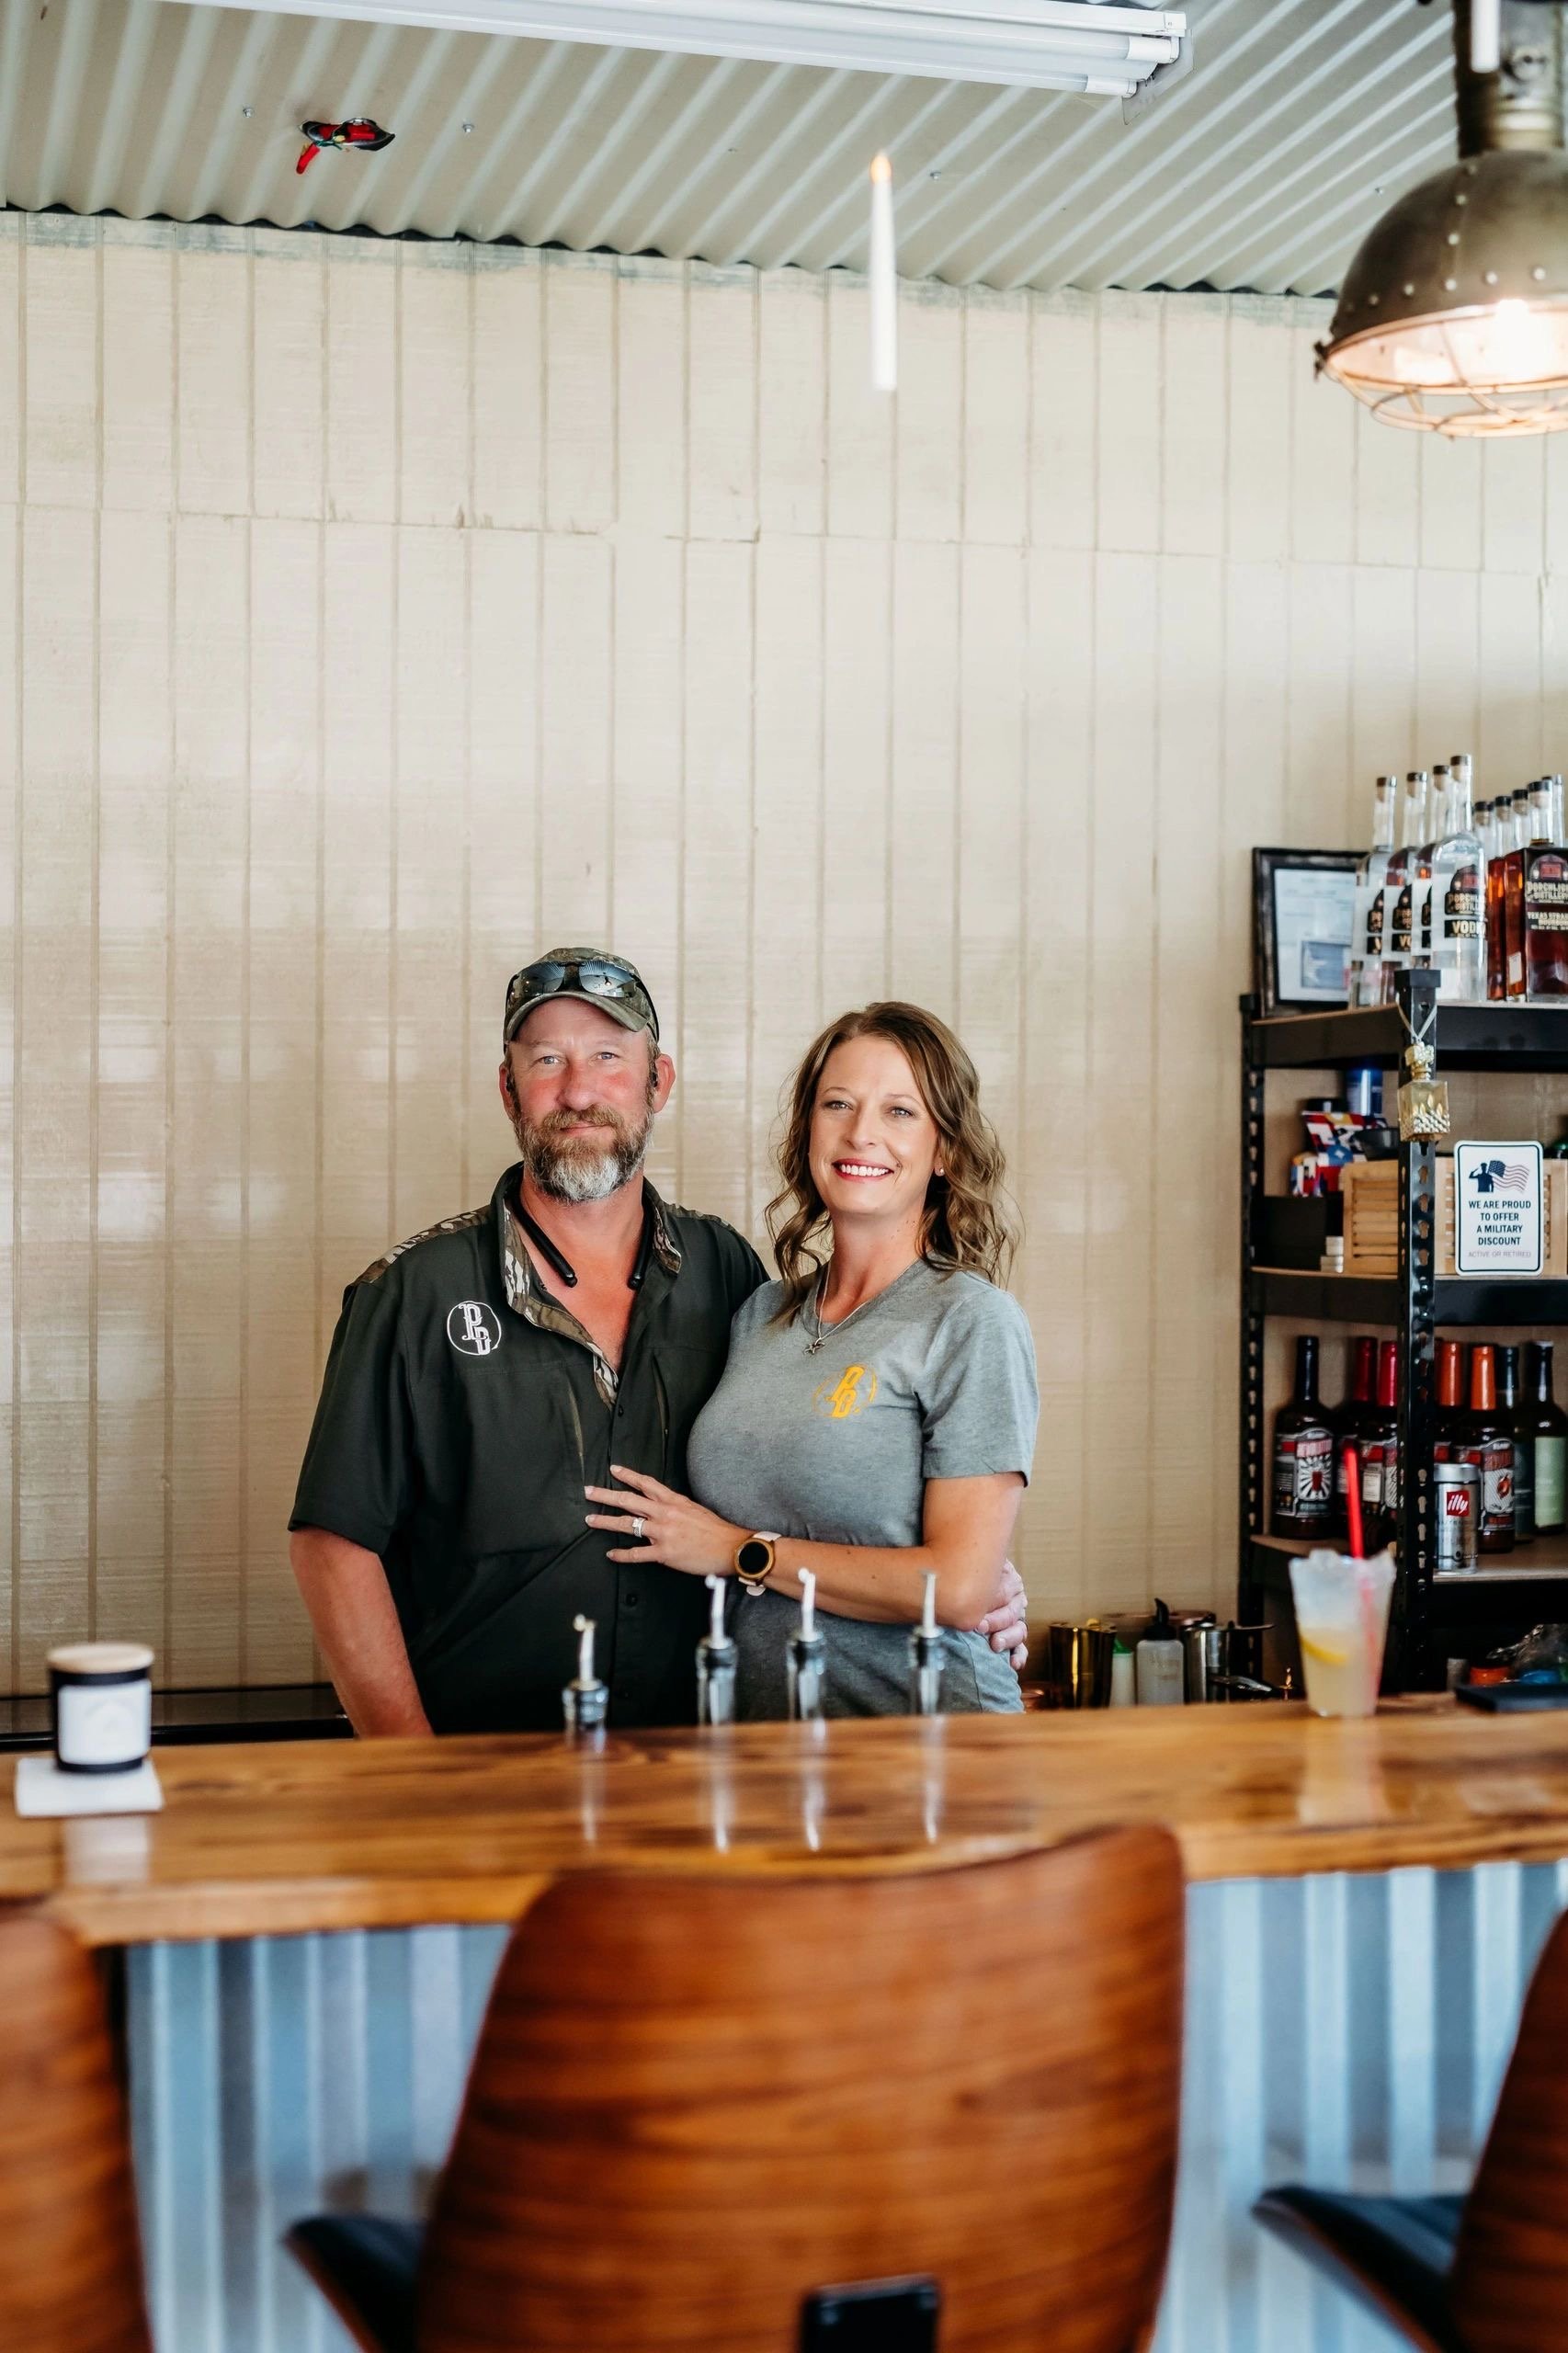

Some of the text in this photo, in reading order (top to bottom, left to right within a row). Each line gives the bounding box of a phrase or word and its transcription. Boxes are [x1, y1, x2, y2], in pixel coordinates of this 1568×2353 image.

[1469, 1200, 1531, 1210] WE ARE PROUD
[1481, 1212, 1519, 1222] TO OFFER
[1476, 1224, 1523, 1233] A MILITARY
[1478, 1237, 1521, 1245] DISCOUNT
[1447, 1494, 1469, 1515] illy
